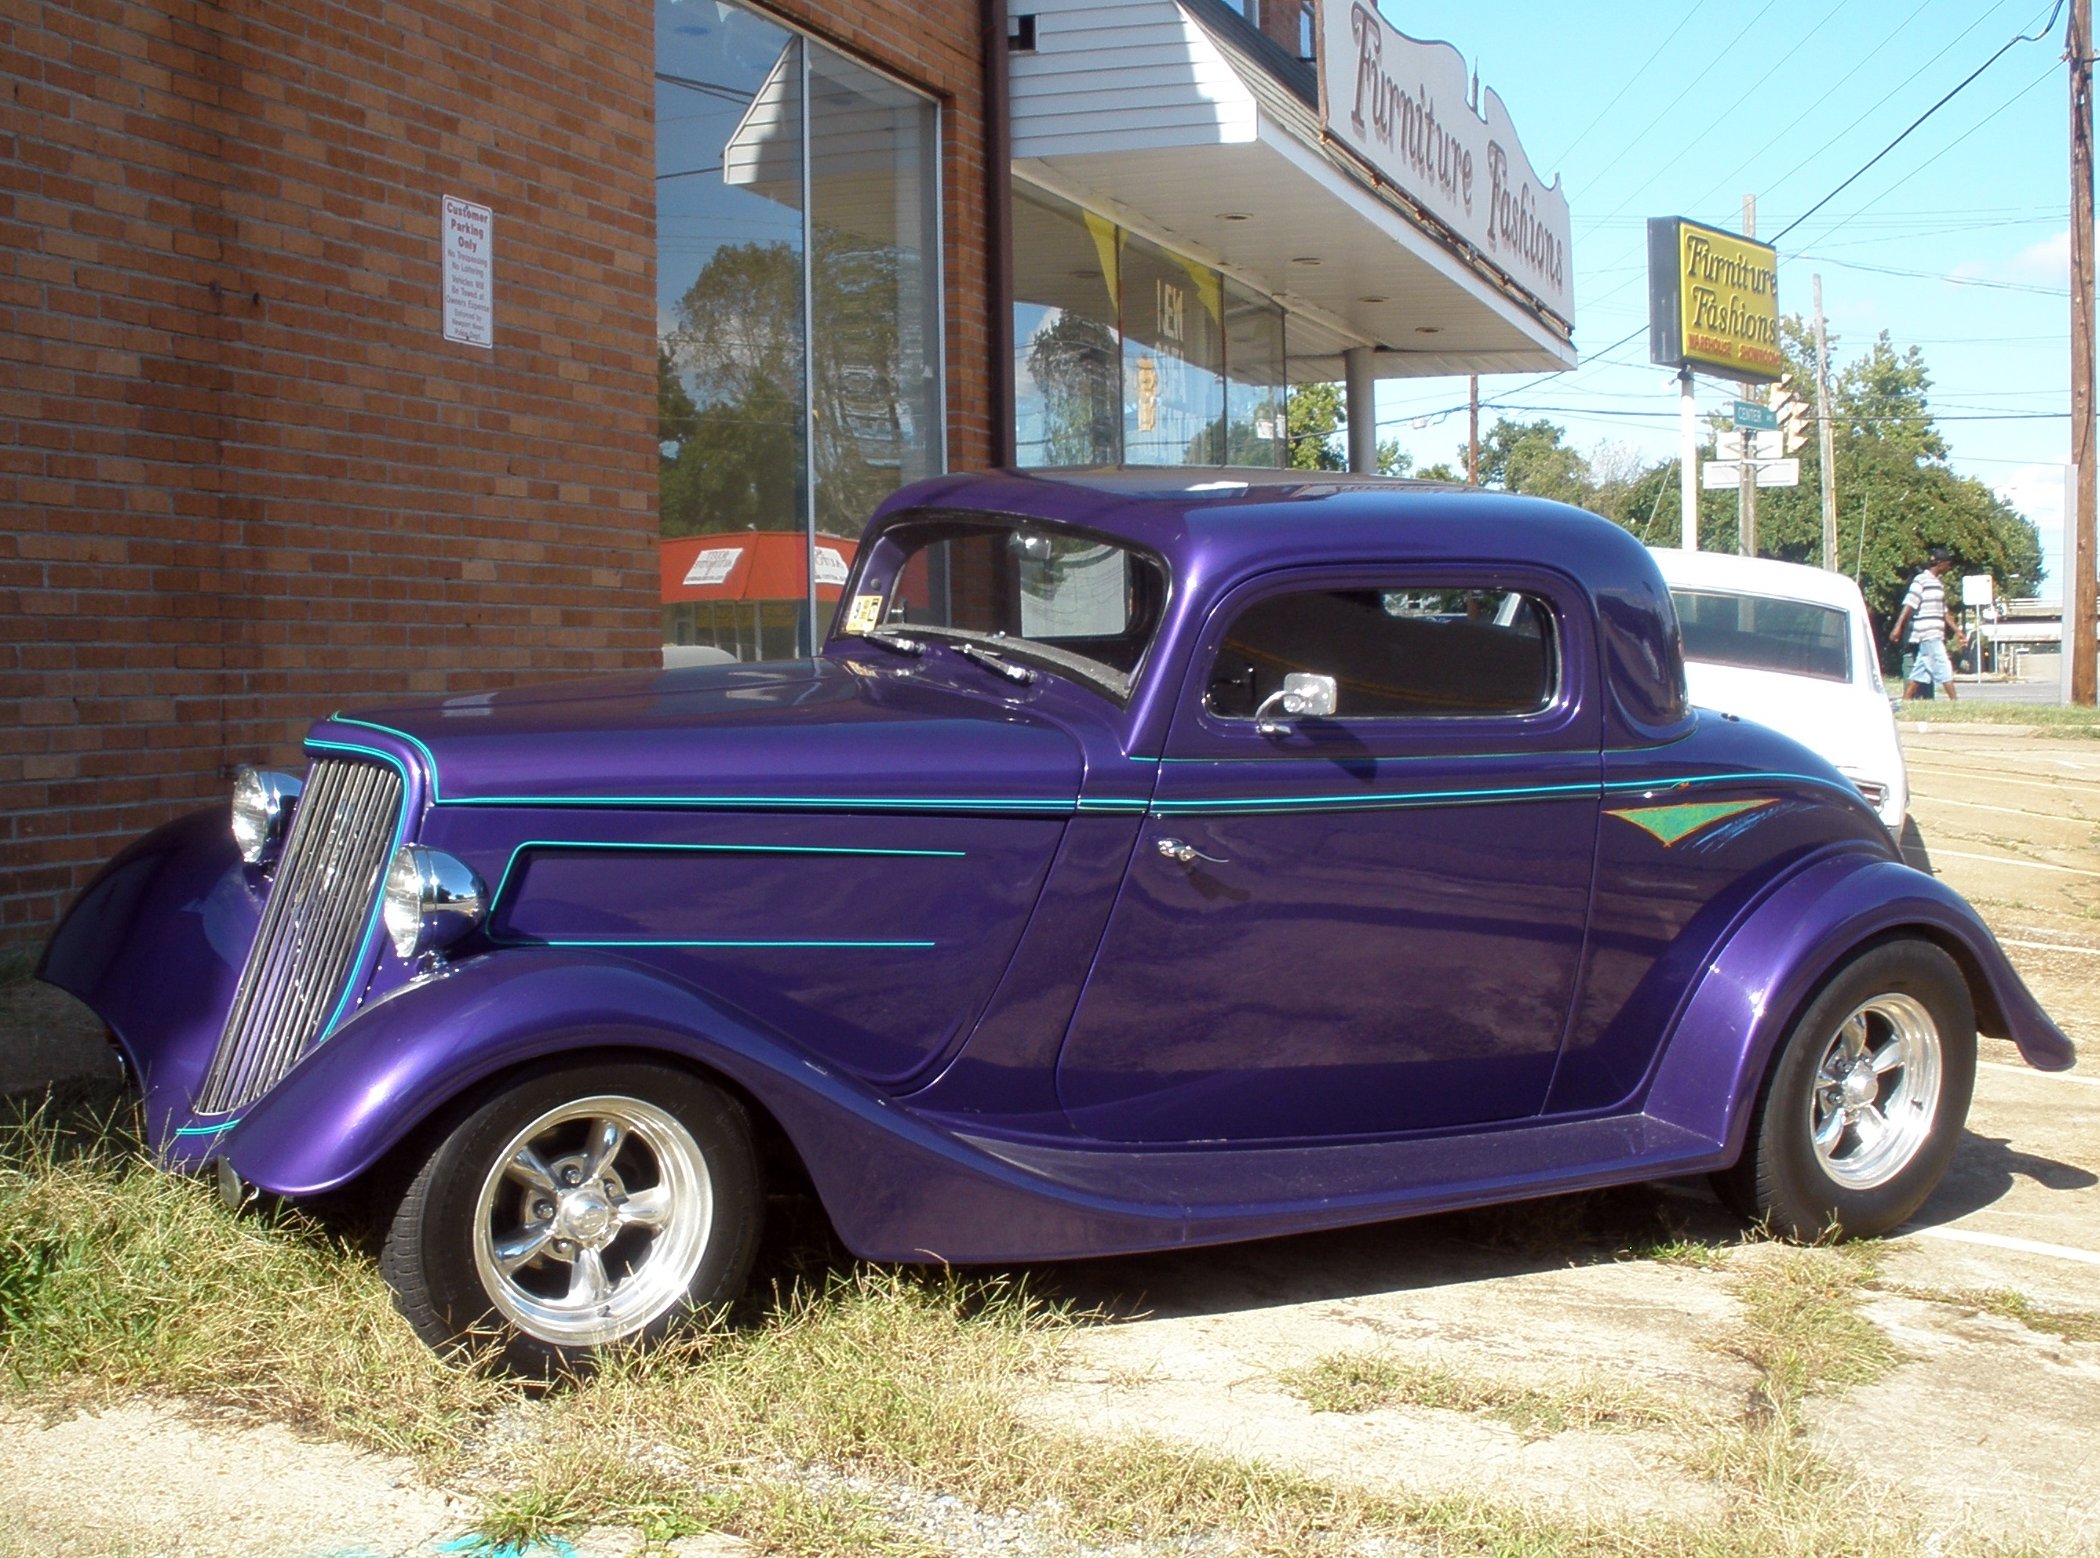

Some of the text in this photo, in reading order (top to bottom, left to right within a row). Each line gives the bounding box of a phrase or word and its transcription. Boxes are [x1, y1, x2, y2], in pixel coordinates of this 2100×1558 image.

[1352, 4, 1563, 289] Furniture Fashions
[447, 202, 488, 224] Customer
[451, 218, 484, 240] Parking
[458, 236, 477, 253] Only
[1687, 235, 1777, 297] Furniture
[1692, 286, 1777, 345] Fashions
[1738, 406, 1761, 423] CENTER
